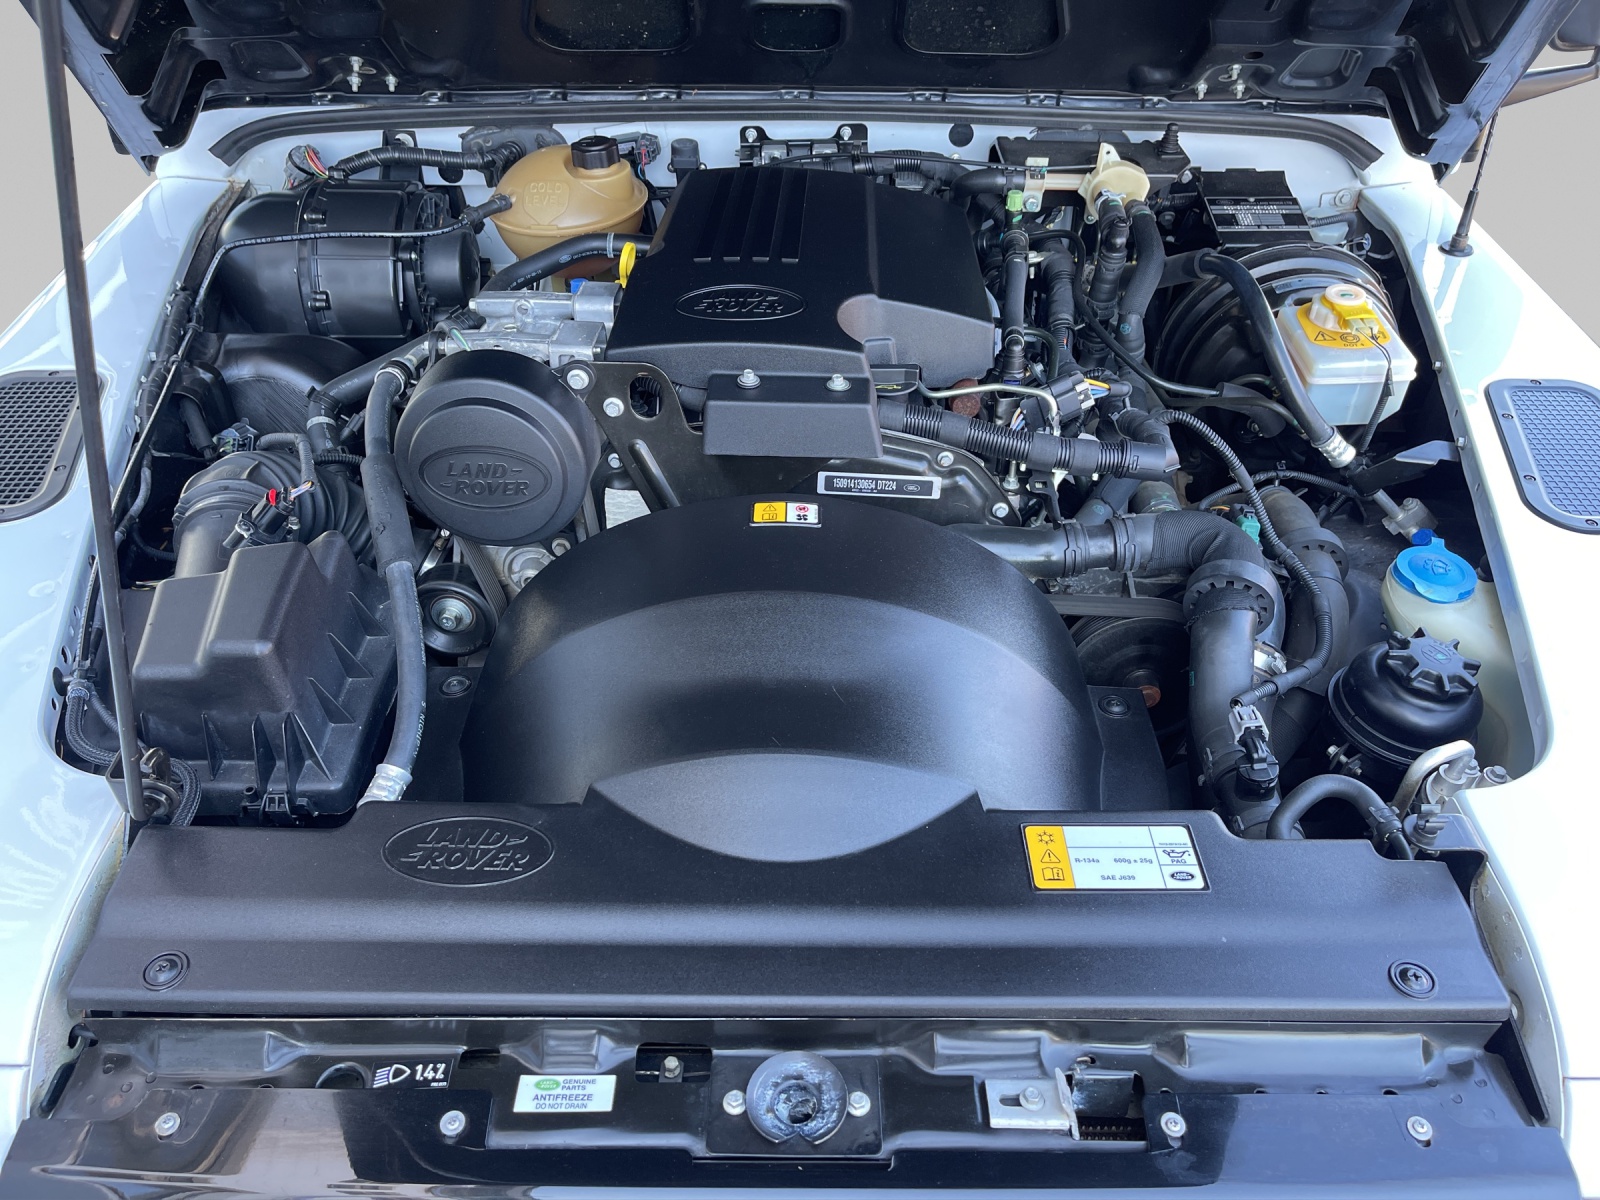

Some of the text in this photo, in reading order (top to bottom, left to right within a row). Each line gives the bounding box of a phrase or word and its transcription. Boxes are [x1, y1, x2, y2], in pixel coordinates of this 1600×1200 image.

[529, 182, 563, 193] COLD
[525, 194, 564, 207] LEVEL
[445, 460, 508, 479] LAND
[453, 479, 530, 496] ROVER
[832, 478, 876, 489] 150914130654
[877, 481, 897, 491] DT224
[416, 827, 509, 849] LAND
[416, 849, 531, 871] ROVER
[1113, 857, 1132, 865] 600g
[1140, 857, 1154, 865] 25g
[415, 1062, 446, 1081] 1.4%
[532, 1093, 594, 1102] ANTIFREEZE
[535, 1102, 588, 1110] DO NOT DRAIN
